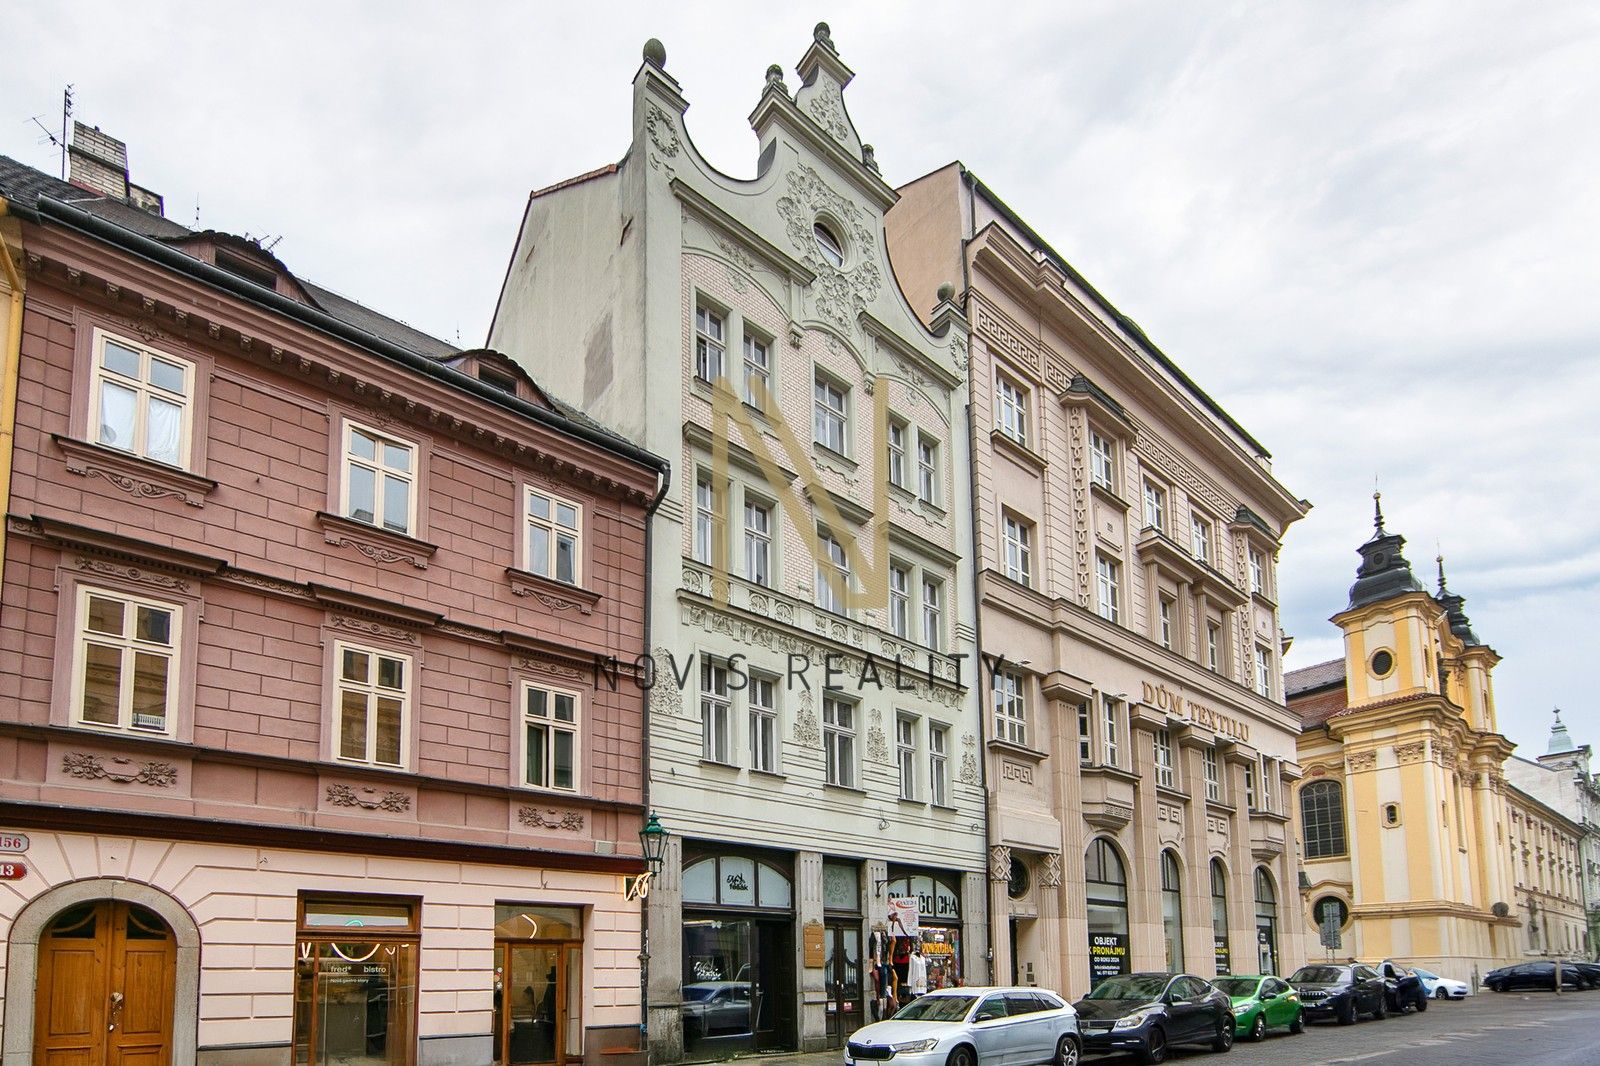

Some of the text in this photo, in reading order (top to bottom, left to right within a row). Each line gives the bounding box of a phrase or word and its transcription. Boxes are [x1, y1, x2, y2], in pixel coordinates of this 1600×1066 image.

[1188, 700, 1249, 742] TEXTILU
[1094, 936, 1118, 946] OBJEKT
[1092, 945, 1126, 955] PRONÁJMU
[363, 965, 387, 973] bistro
